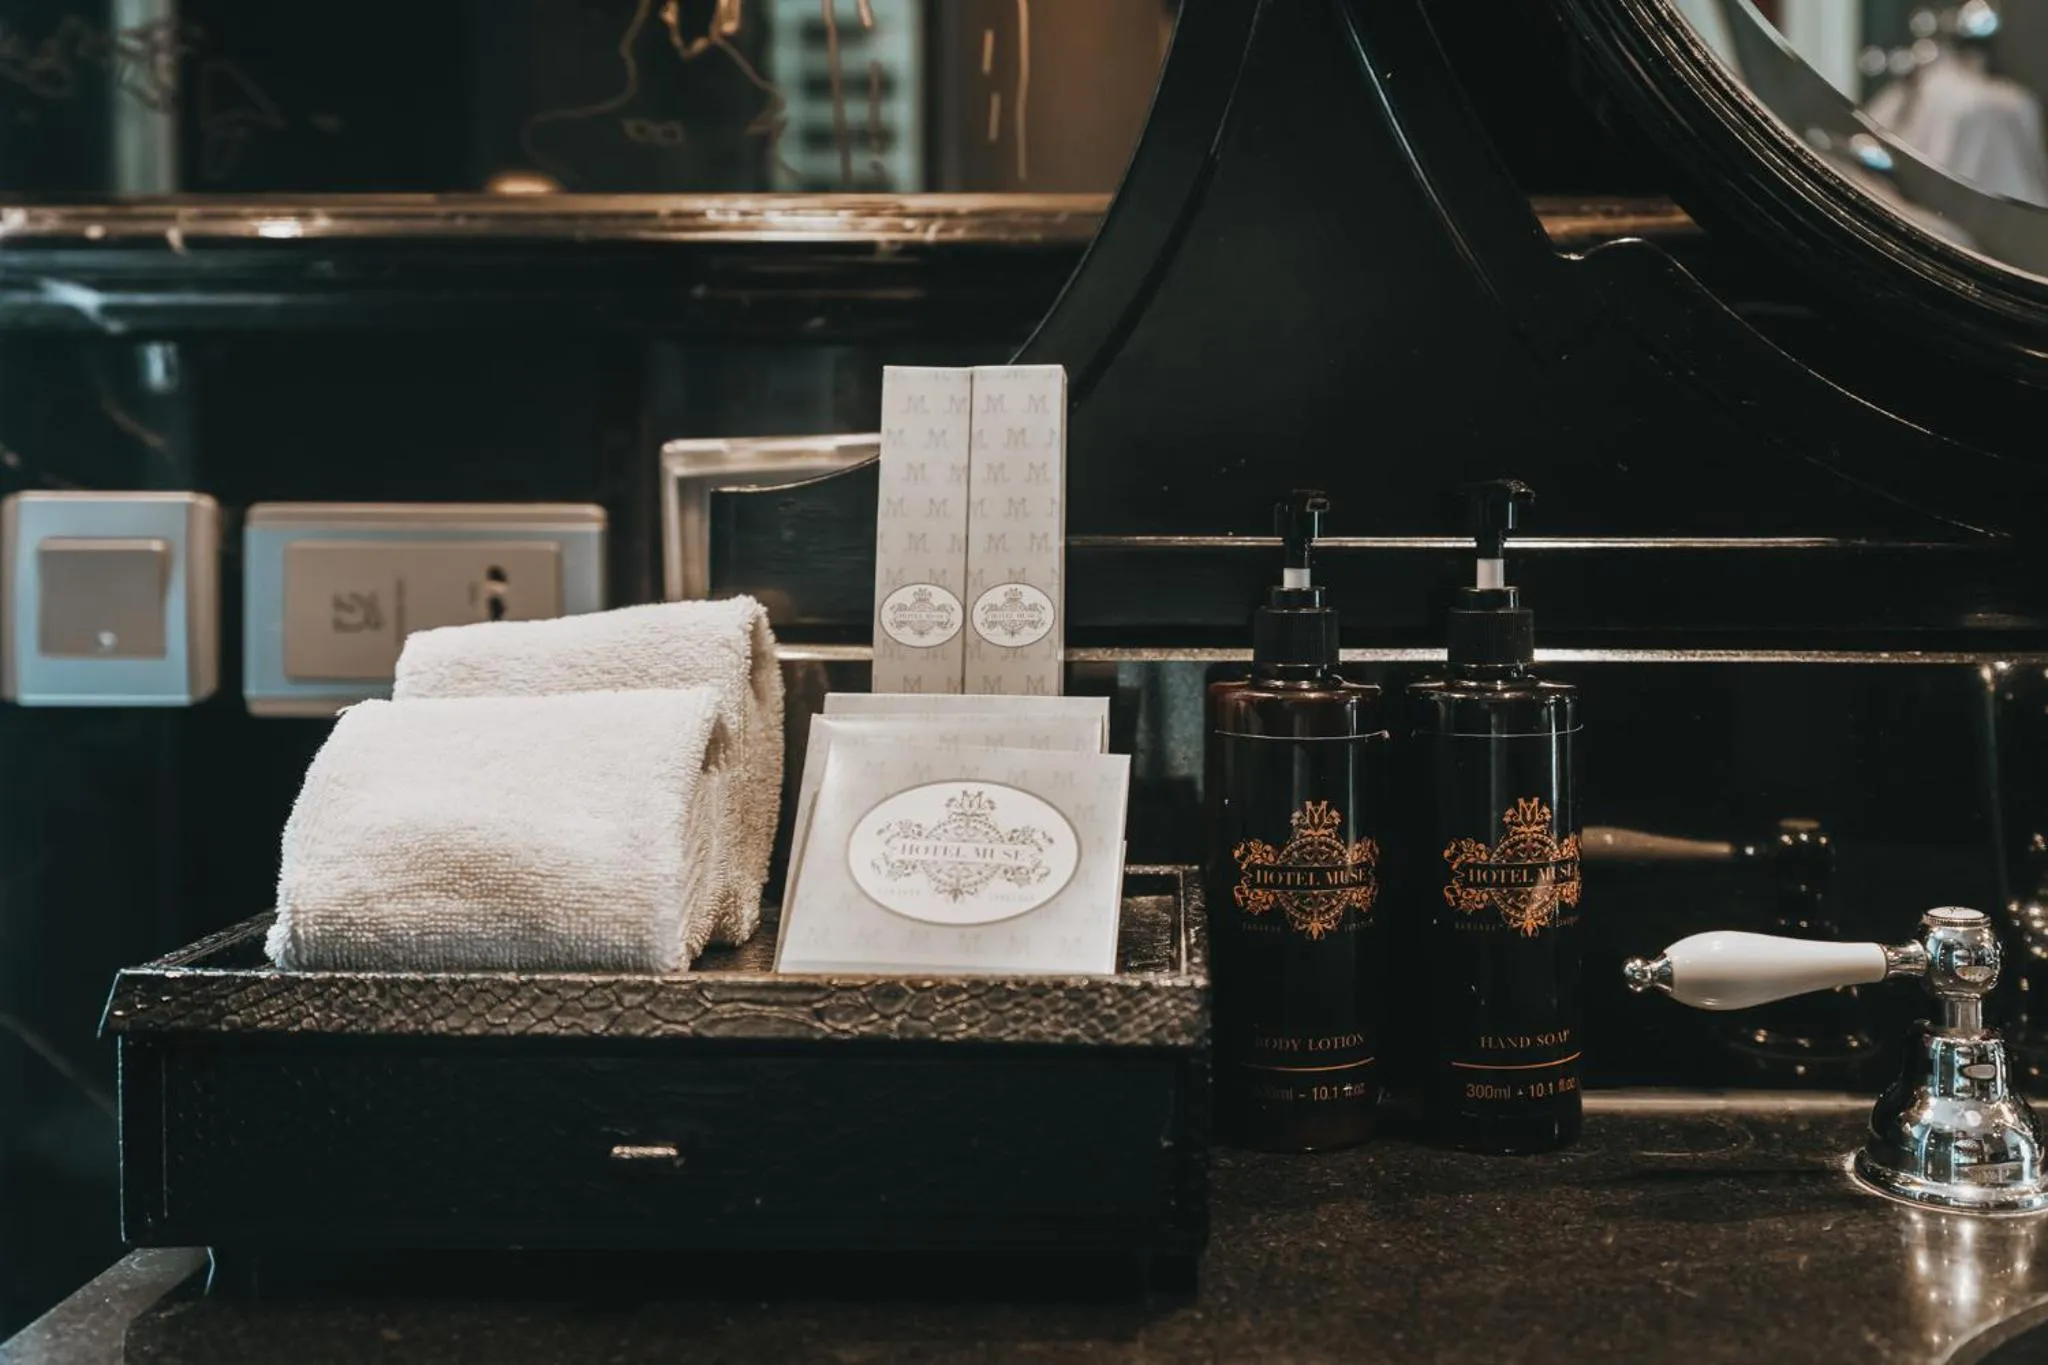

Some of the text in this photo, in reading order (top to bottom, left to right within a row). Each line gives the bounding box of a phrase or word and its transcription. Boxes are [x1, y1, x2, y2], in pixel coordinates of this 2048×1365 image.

[899, 843, 968, 858] HOTEL
[1255, 865, 1367, 886] HOTEL MUSE
[1468, 863, 1576, 884] HOTEL MUSE
[1308, 1032, 1365, 1051] LOTION
[1480, 1028, 1571, 1049] HAND SOAP
[1466, 1082, 1512, 1099] 300ml
